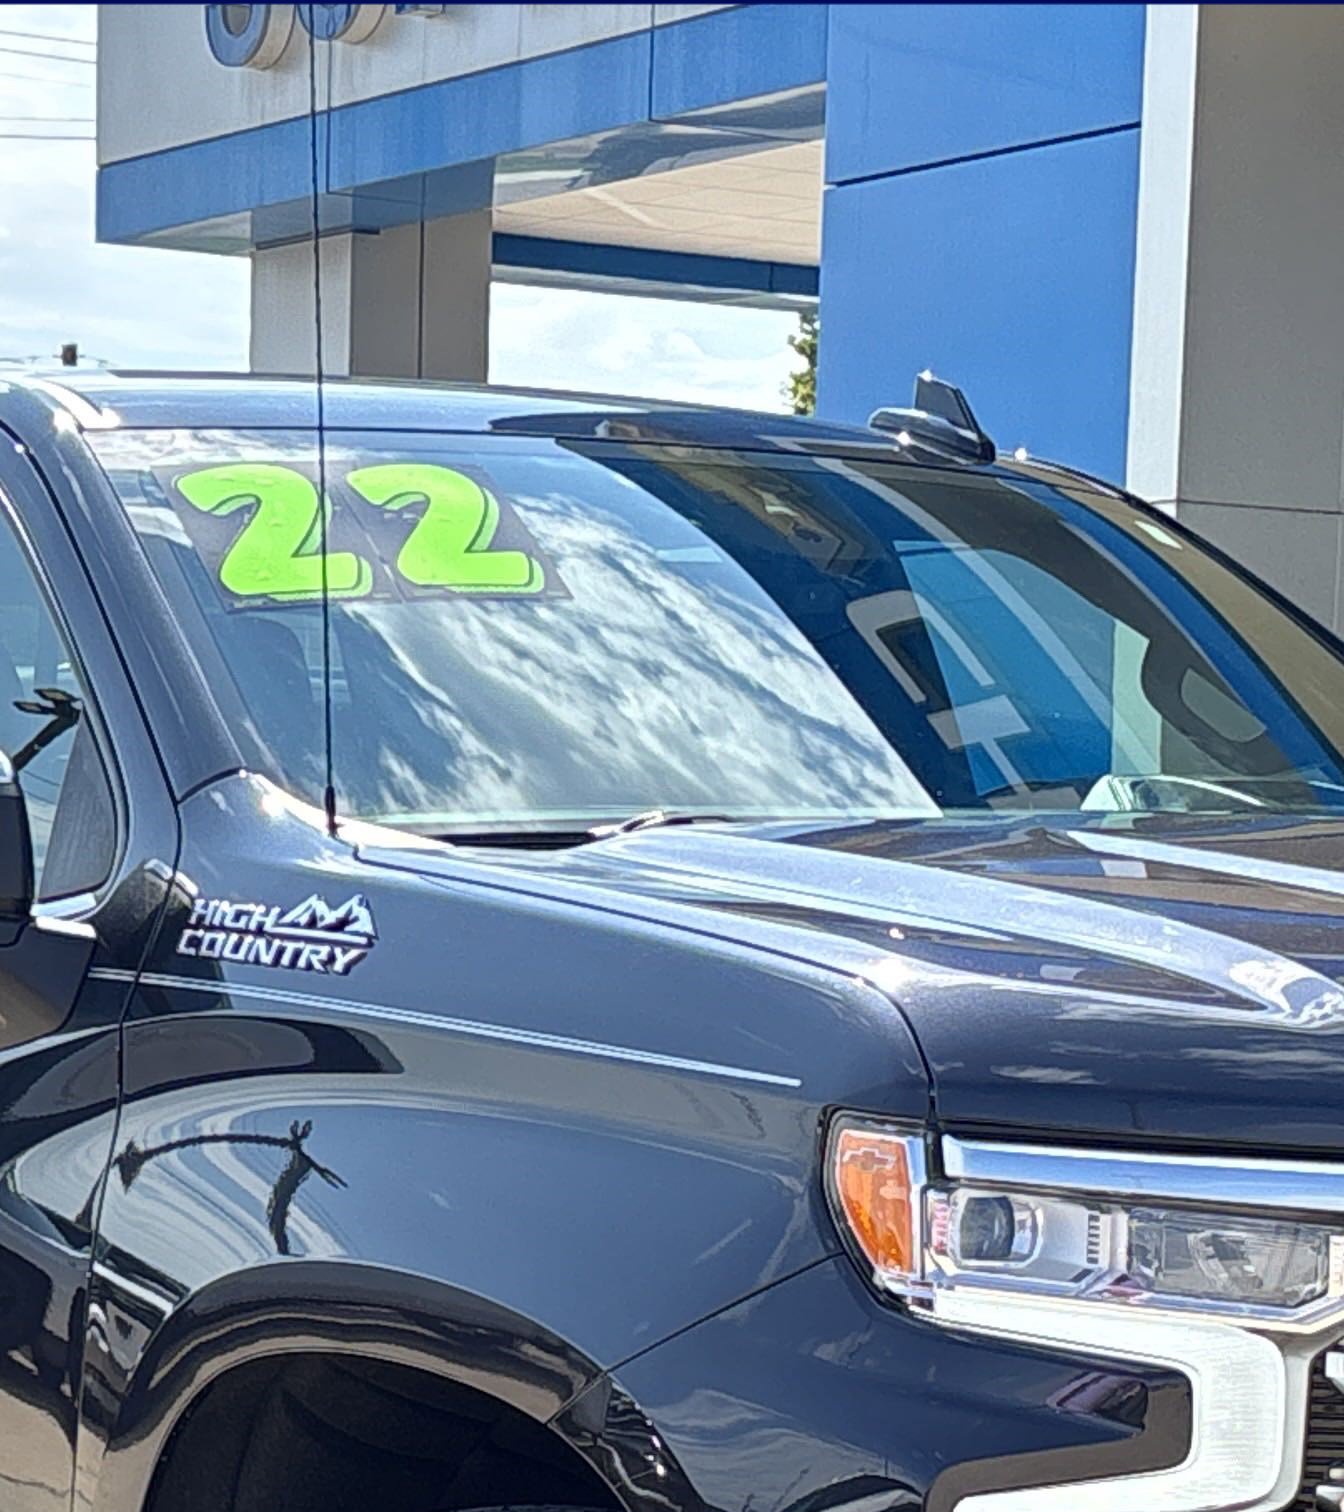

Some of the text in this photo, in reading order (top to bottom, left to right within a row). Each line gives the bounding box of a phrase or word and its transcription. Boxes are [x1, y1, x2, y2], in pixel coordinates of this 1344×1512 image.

[174, 464, 546, 601] 22
[188, 898, 282, 932] HIGH
[176, 928, 368, 974] COUNTRY
